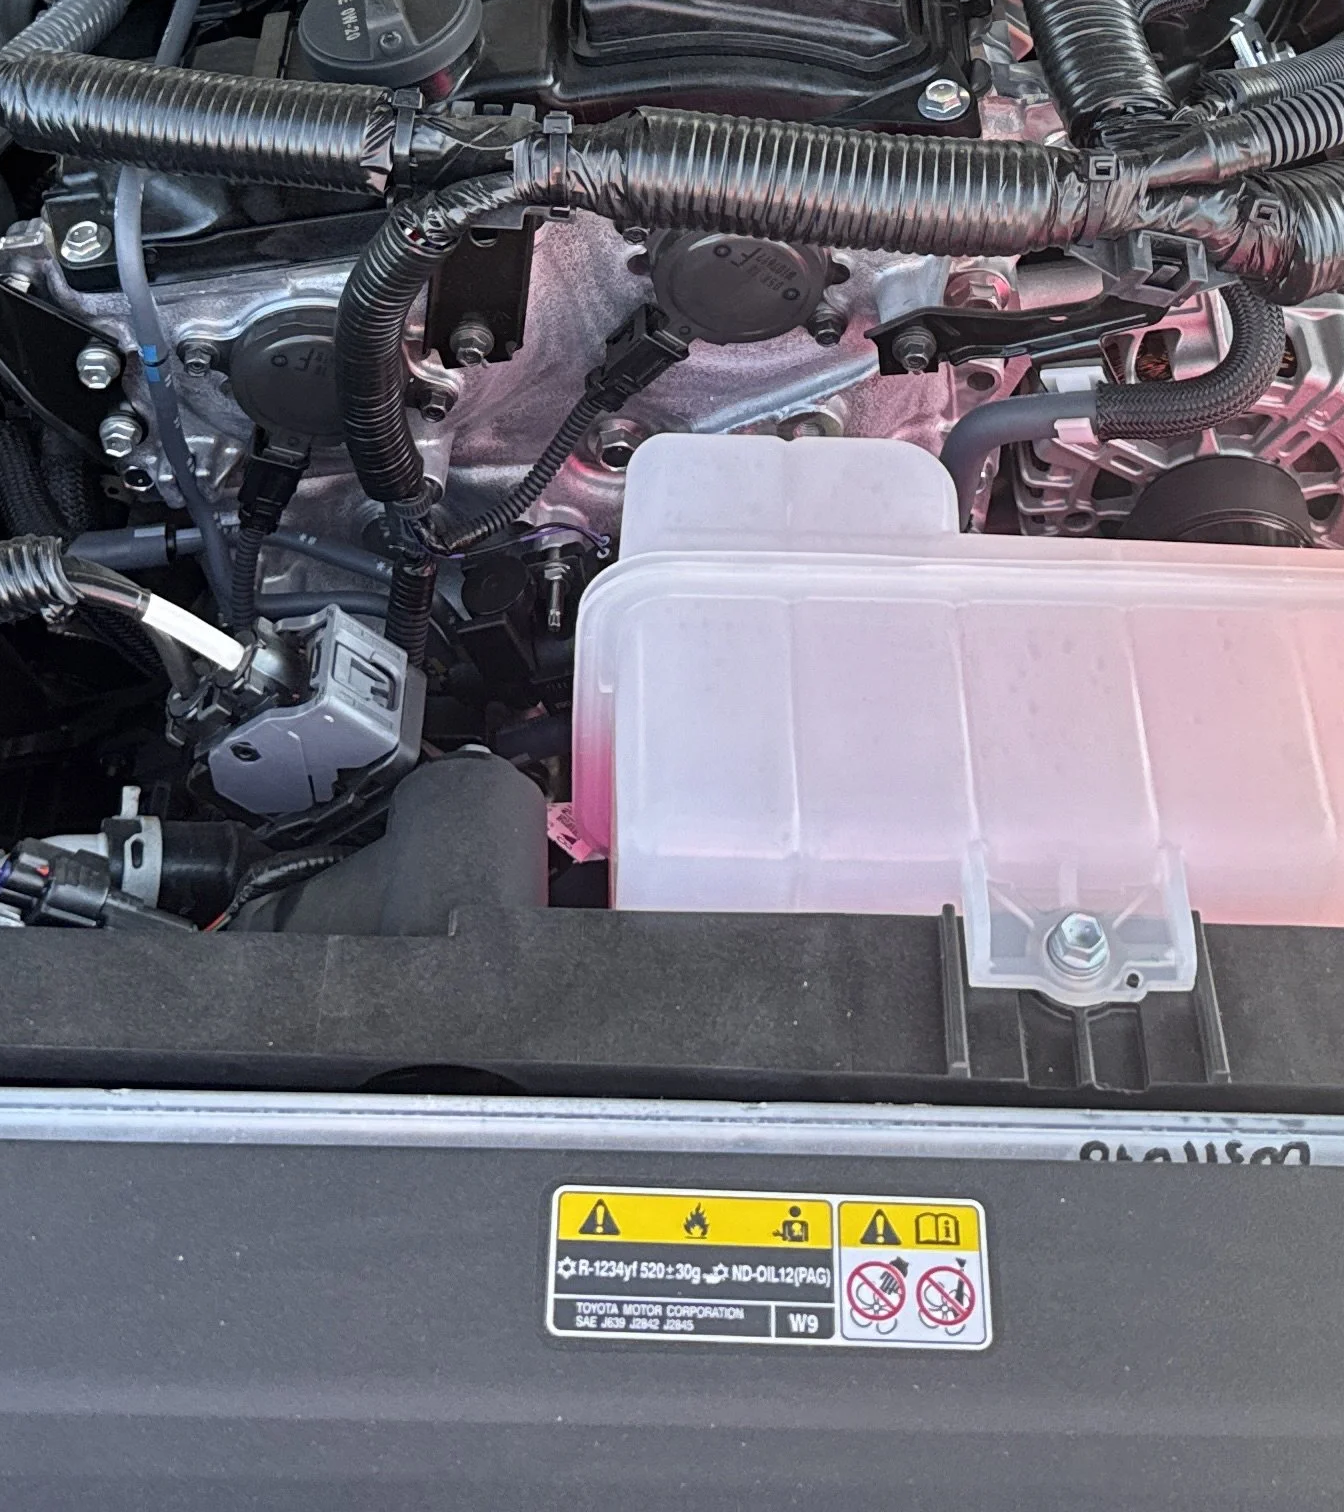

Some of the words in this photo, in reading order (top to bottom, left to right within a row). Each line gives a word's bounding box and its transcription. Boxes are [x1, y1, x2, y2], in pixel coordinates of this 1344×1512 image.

[340, 7, 361, 41] 0W-20
[577, 1259, 637, 1282] R-1234yf
[642, 1262, 702, 1285] 520±30g
[731, 1265, 832, 1288] ND-OIL12(PAG)
[575, 1301, 619, 1315] TOYOTA
[622, 1303, 662, 1316] MOTOR
[666, 1304, 745, 1320] CORPORATION
[575, 1315, 598, 1328] SAE
[601, 1316, 626, 1329] J639
[629, 1317, 660, 1330] J2842
[662, 1318, 695, 1332] J2845
[789, 1313, 820, 1334] W9
